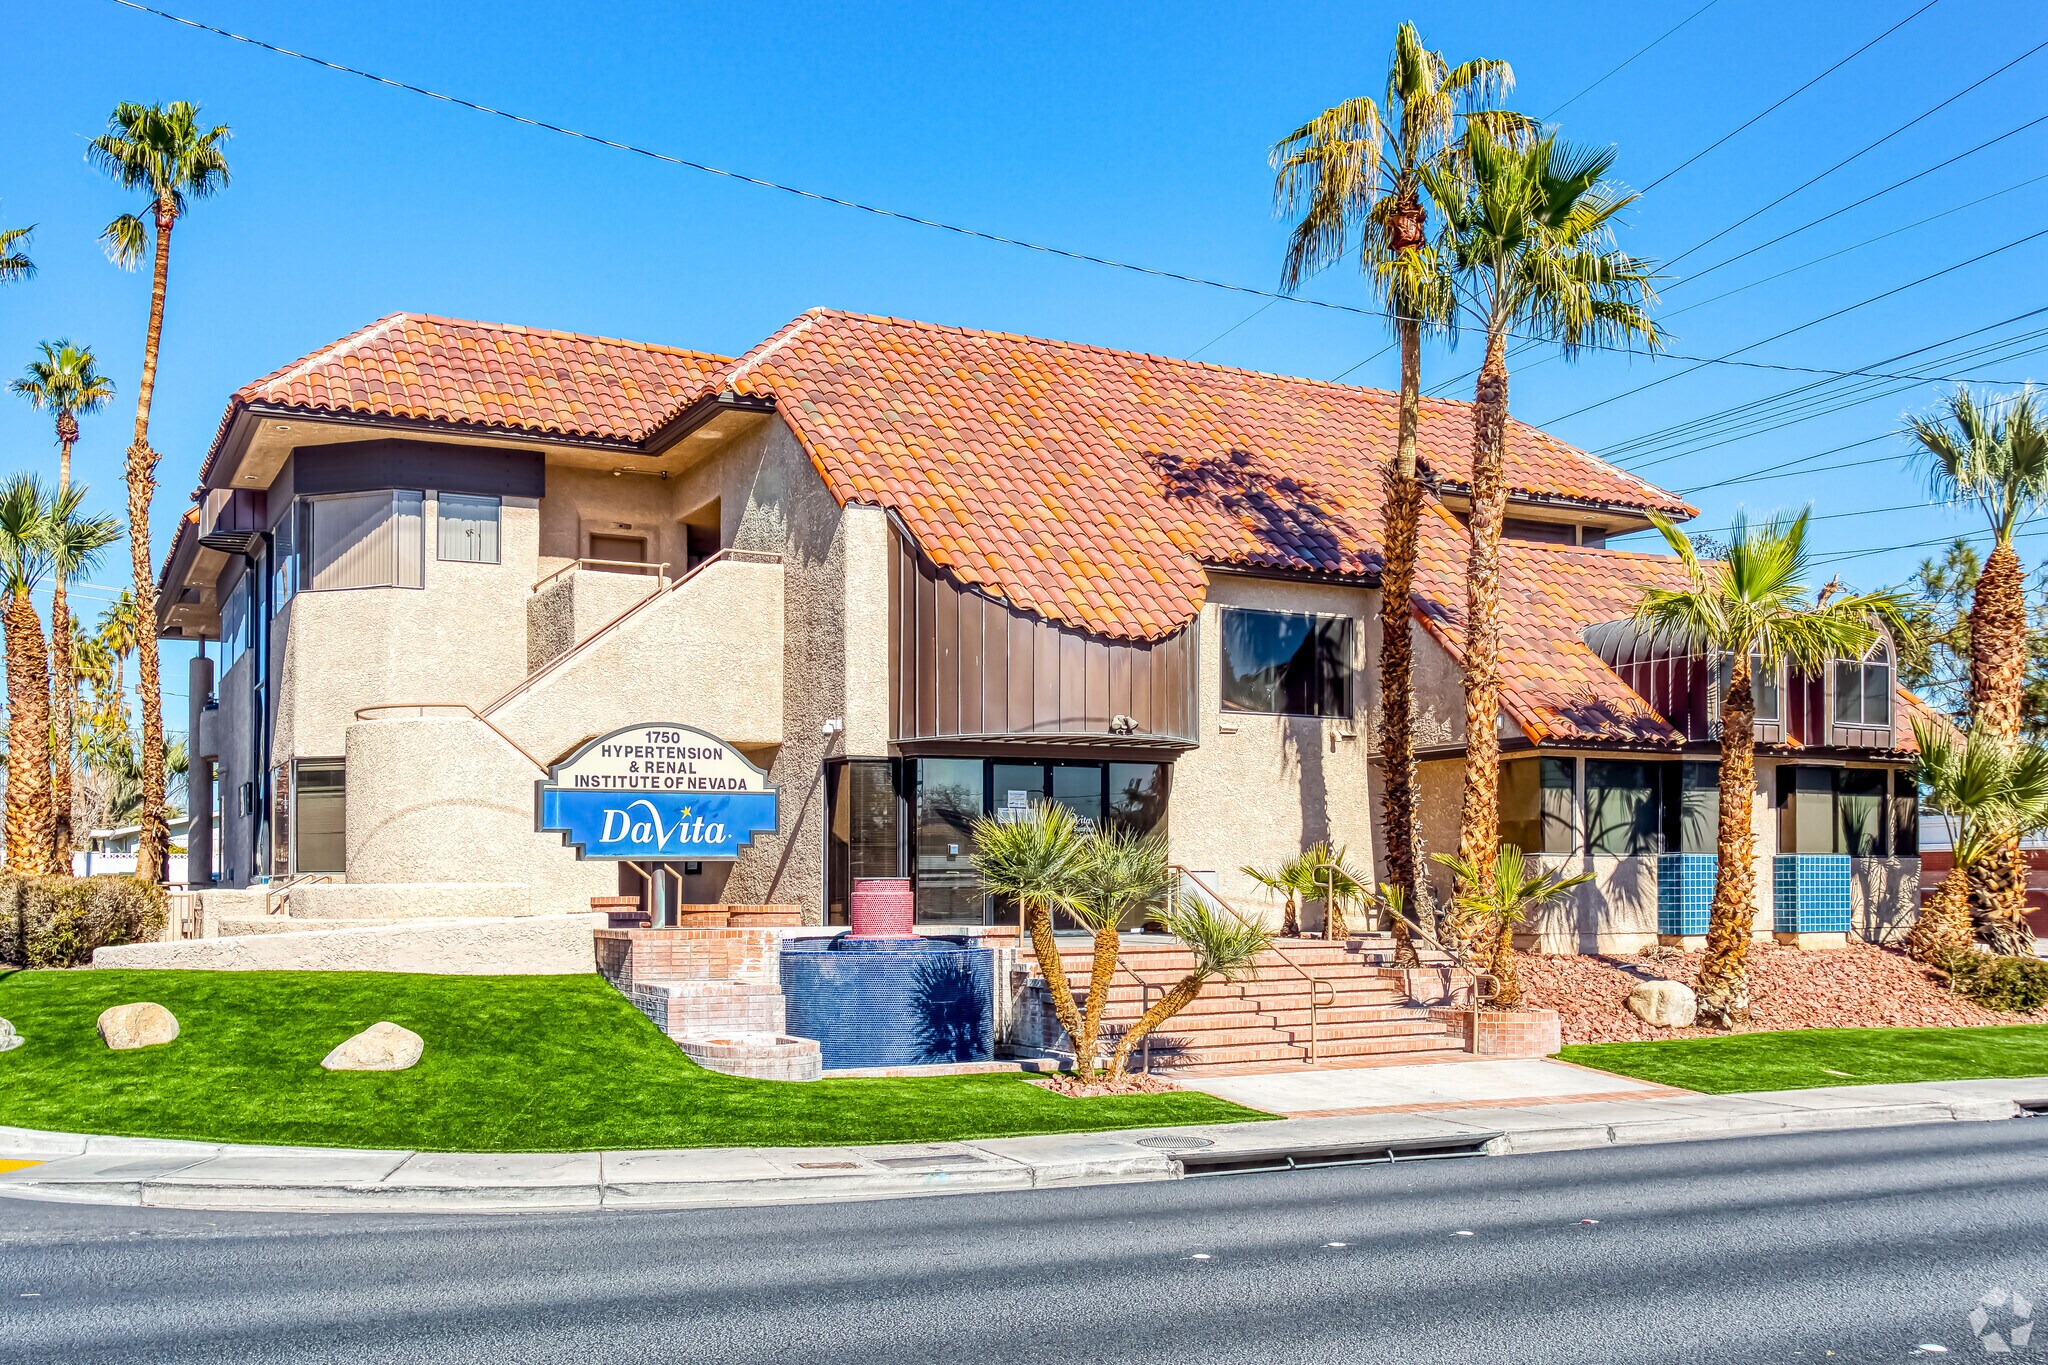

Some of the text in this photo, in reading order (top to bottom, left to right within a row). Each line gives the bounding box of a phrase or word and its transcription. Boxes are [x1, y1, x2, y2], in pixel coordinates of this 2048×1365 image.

[645, 731, 681, 744] 1750
[601, 745, 723, 760] HYPERTENSION
[629, 761, 697, 774] & RENAL
[574, 774, 748, 791] INSTITUTE OF NEVADA
[599, 799, 726, 851] DaVita
